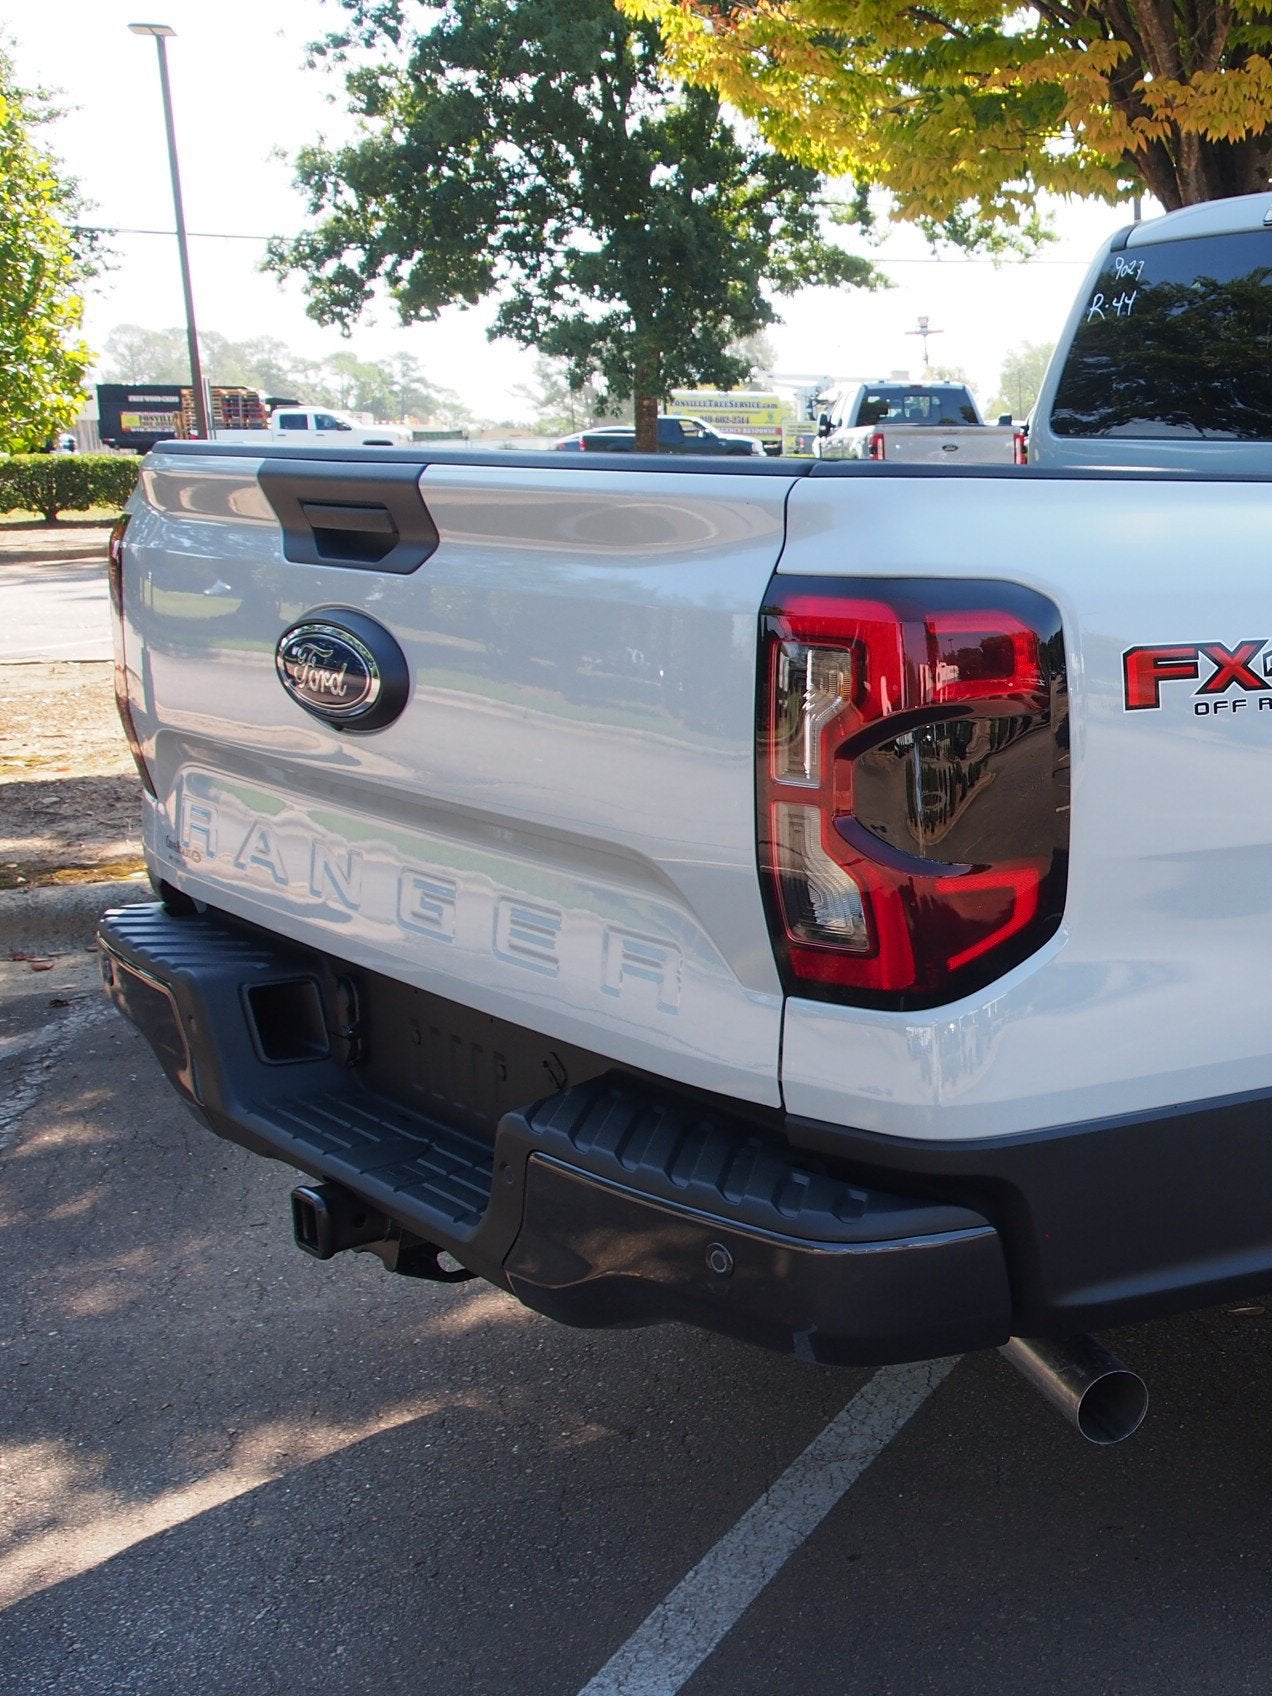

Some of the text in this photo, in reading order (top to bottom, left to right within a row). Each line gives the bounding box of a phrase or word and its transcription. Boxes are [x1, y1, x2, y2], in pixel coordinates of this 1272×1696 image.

[288, 642, 348, 697] Ford
[1193, 699, 1247, 716] OFF
[182, 799, 683, 1015] RANGER
